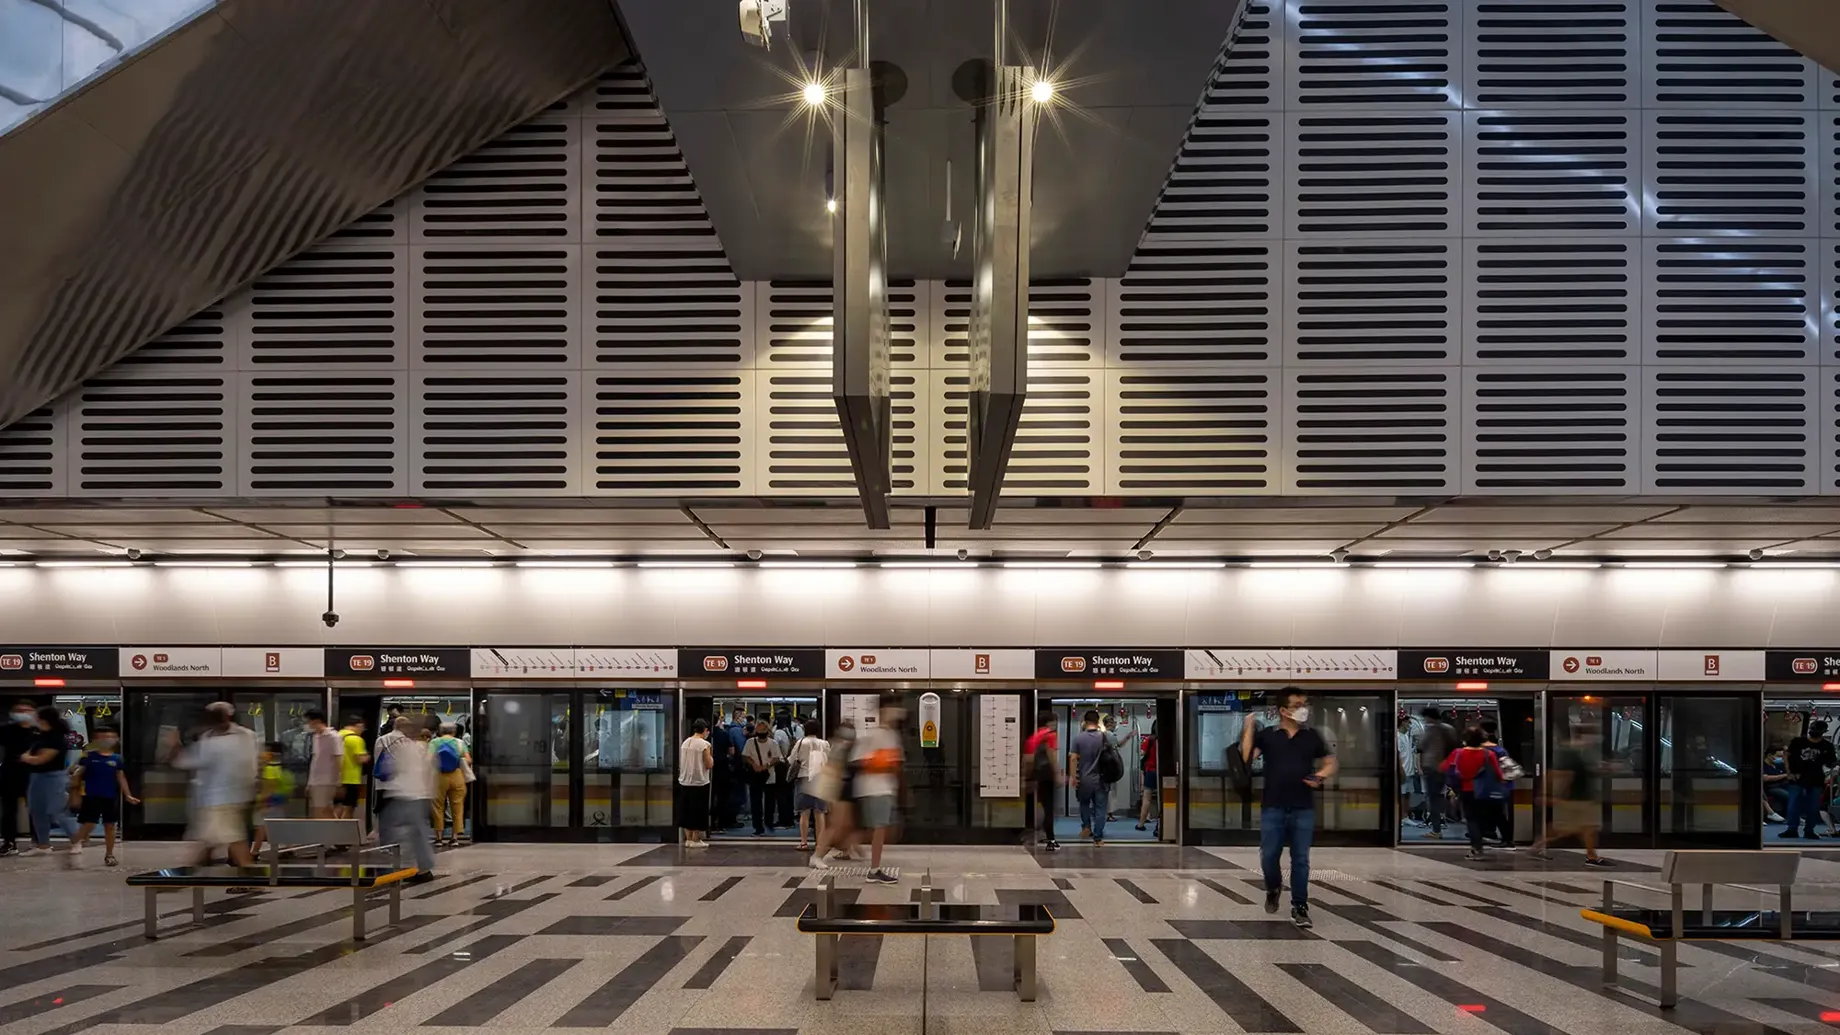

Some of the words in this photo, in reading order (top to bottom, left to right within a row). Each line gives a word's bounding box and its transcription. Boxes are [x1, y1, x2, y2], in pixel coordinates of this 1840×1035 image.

[3, 658, 11, 666] TE
[13, 658, 21, 666] 19
[29, 652, 66, 662] Shenton
[67, 653, 87, 663] Way
[268, 655, 277, 666] B
[380, 654, 418, 663] Shenton
[420, 655, 439, 665] Way
[734, 655, 772, 664] Shenton
[774, 655, 794, 666] Way
[978, 657, 986, 668] B
[1092, 656, 1130, 665] Shenton
[1132, 656, 1153, 666] Way
[1455, 656, 1494, 665] Shenton
[1496, 656, 1517, 667] Way
[1063, 660, 1073, 668] TE
[1075, 660, 1084, 668] 19
[1426, 661, 1436, 669] TE
[1437, 661, 1447, 669] 19
[1708, 658, 1716, 669] B
